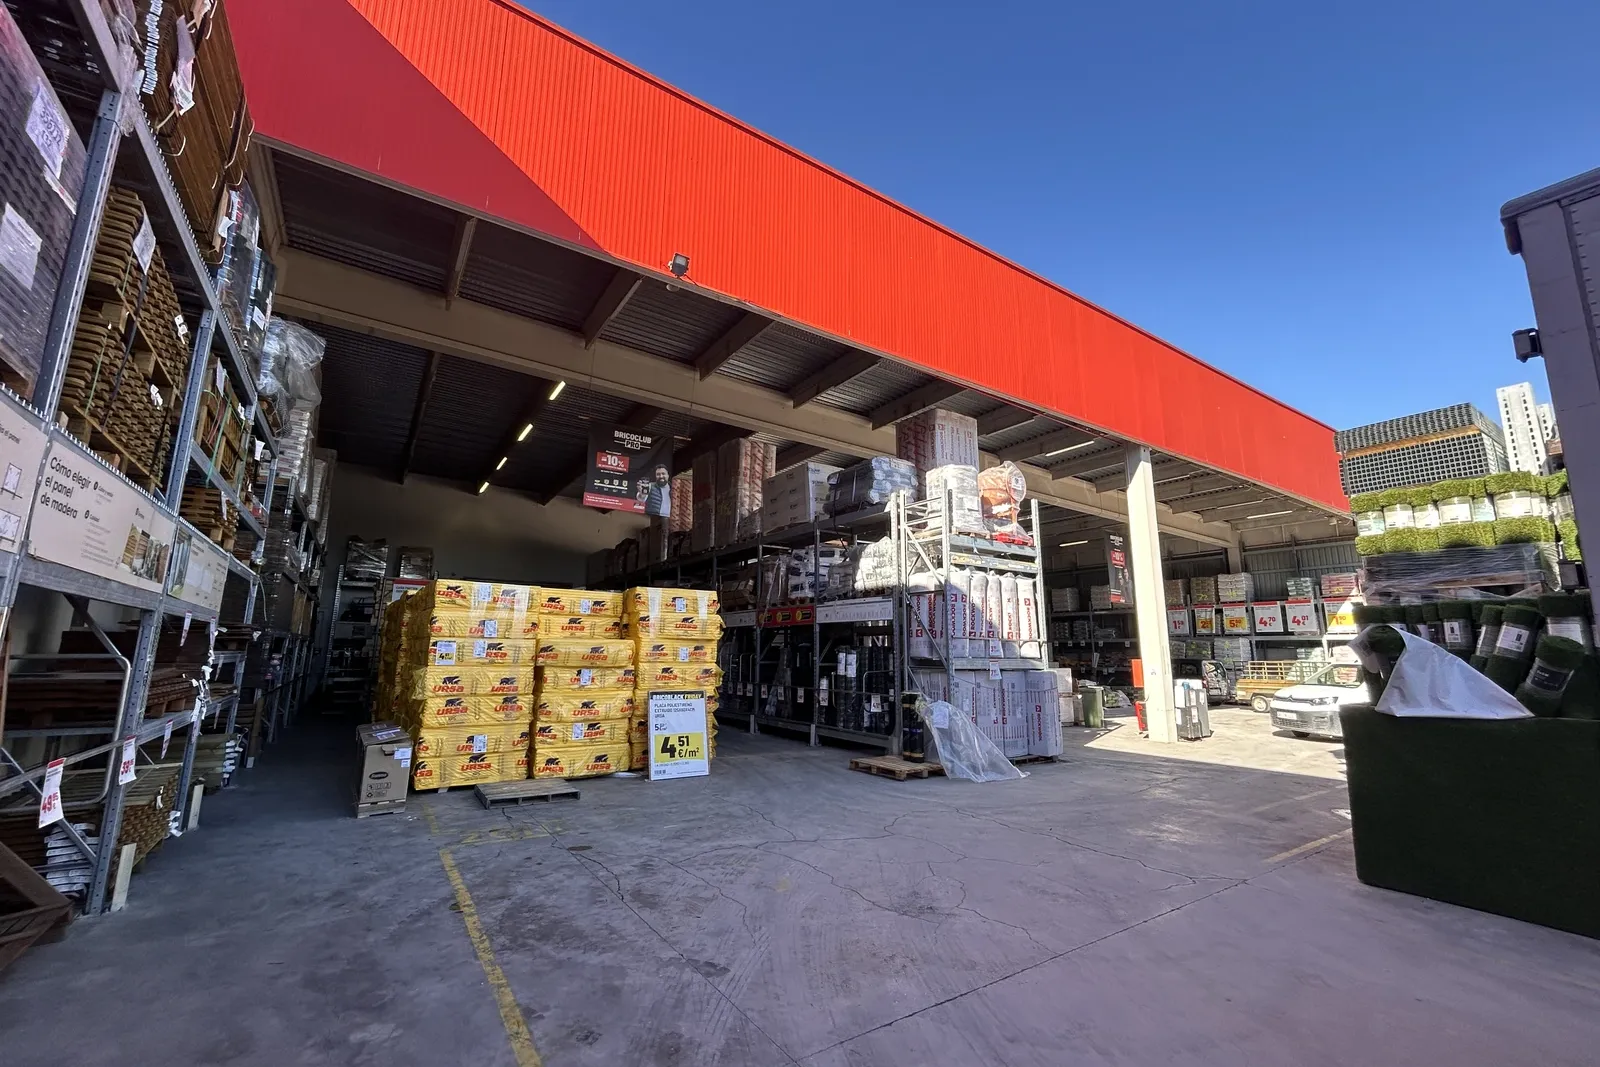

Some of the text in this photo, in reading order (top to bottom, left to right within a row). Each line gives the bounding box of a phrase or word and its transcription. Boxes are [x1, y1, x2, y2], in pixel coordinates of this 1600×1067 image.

[614, 430, 652, 444] BRICOCLUB
[626, 441, 640, 449] PRO
[50, 457, 91, 489] Cómo elegir
[45, 476, 74, 498] el panel
[40, 492, 50, 506] de
[51, 498, 78, 518] madera
[541, 603, 565, 611] URSA
[1259, 617, 1268, 626] 4
[1292, 616, 1301, 626] 4
[433, 685, 464, 694] URSA
[436, 706, 468, 716] URSA
[494, 704, 523, 712] URSA
[572, 708, 600, 717] URSA
[456, 744, 474, 752] UR
[661, 736, 689, 758] 4 51
[678, 747, 700, 758] €/m²
[461, 763, 492, 772] URSA
[586, 763, 612, 772] URSA
[42, 794, 52, 813] 49
